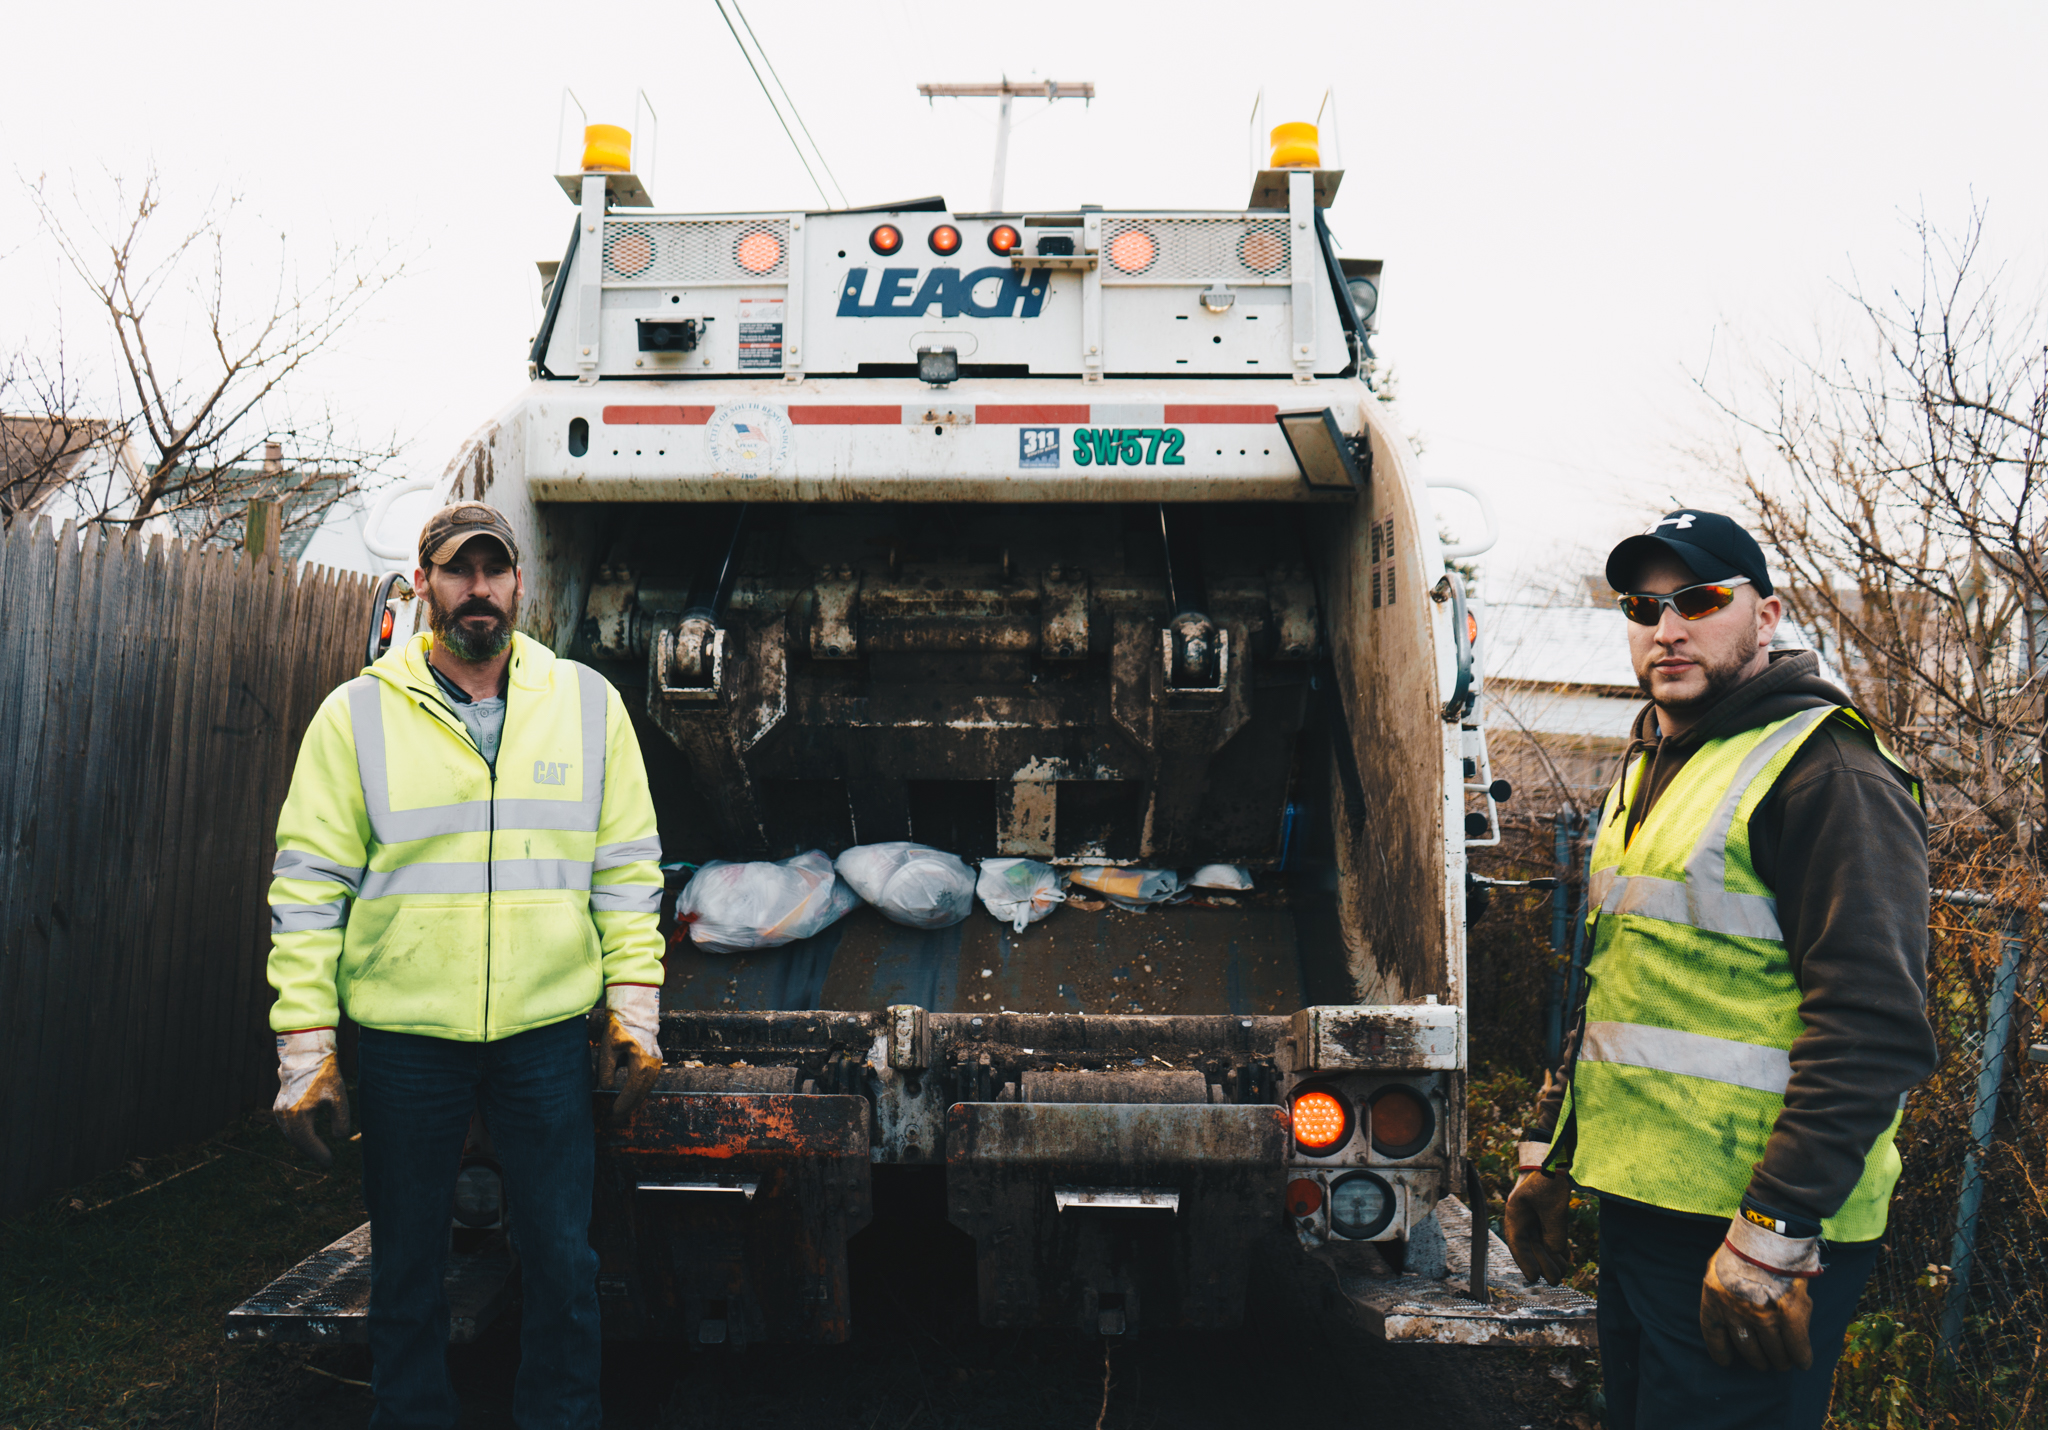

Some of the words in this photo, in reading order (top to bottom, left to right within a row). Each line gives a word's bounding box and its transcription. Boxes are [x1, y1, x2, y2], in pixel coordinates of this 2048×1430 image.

[836, 266, 1053, 318] LEACH
[719, 411, 728, 422] OF
[729, 403, 760, 413] SOUTH
[710, 422, 720, 443] CITY
[776, 425, 789, 461] INDIANA
[1023, 430, 1055, 454] 311
[710, 445, 721, 462] THE
[1073, 428, 1186, 466] SW572
[533, 760, 569, 786] CAT
